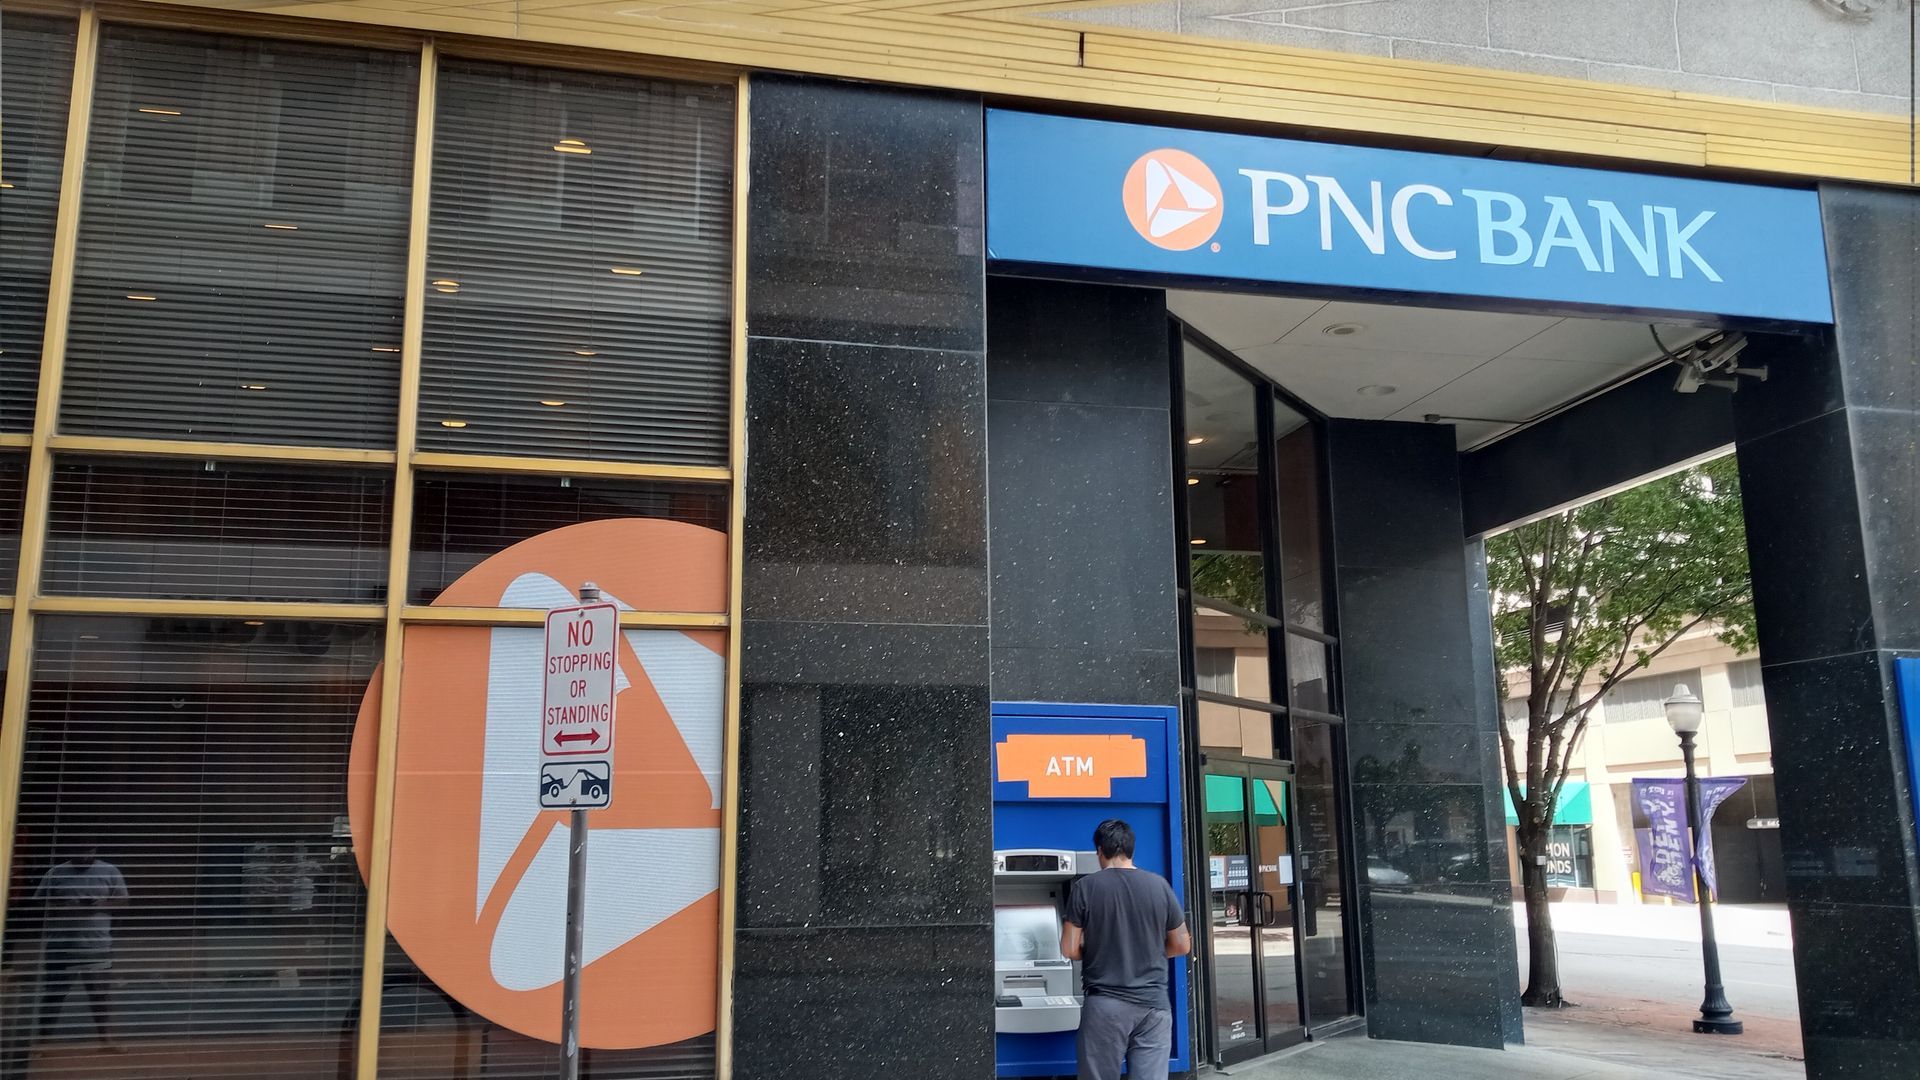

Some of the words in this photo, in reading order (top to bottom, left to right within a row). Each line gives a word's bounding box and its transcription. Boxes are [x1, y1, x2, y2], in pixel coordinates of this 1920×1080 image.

[1238, 167, 1457, 261] PNC
[1461, 188, 1724, 283] BANK
[567, 619, 594, 648] NO
[549, 651, 611, 675] STOPPING
[570, 679, 587, 698] OR
[547, 703, 609, 726] STANDING
[1045, 756, 1095, 777] ATM
